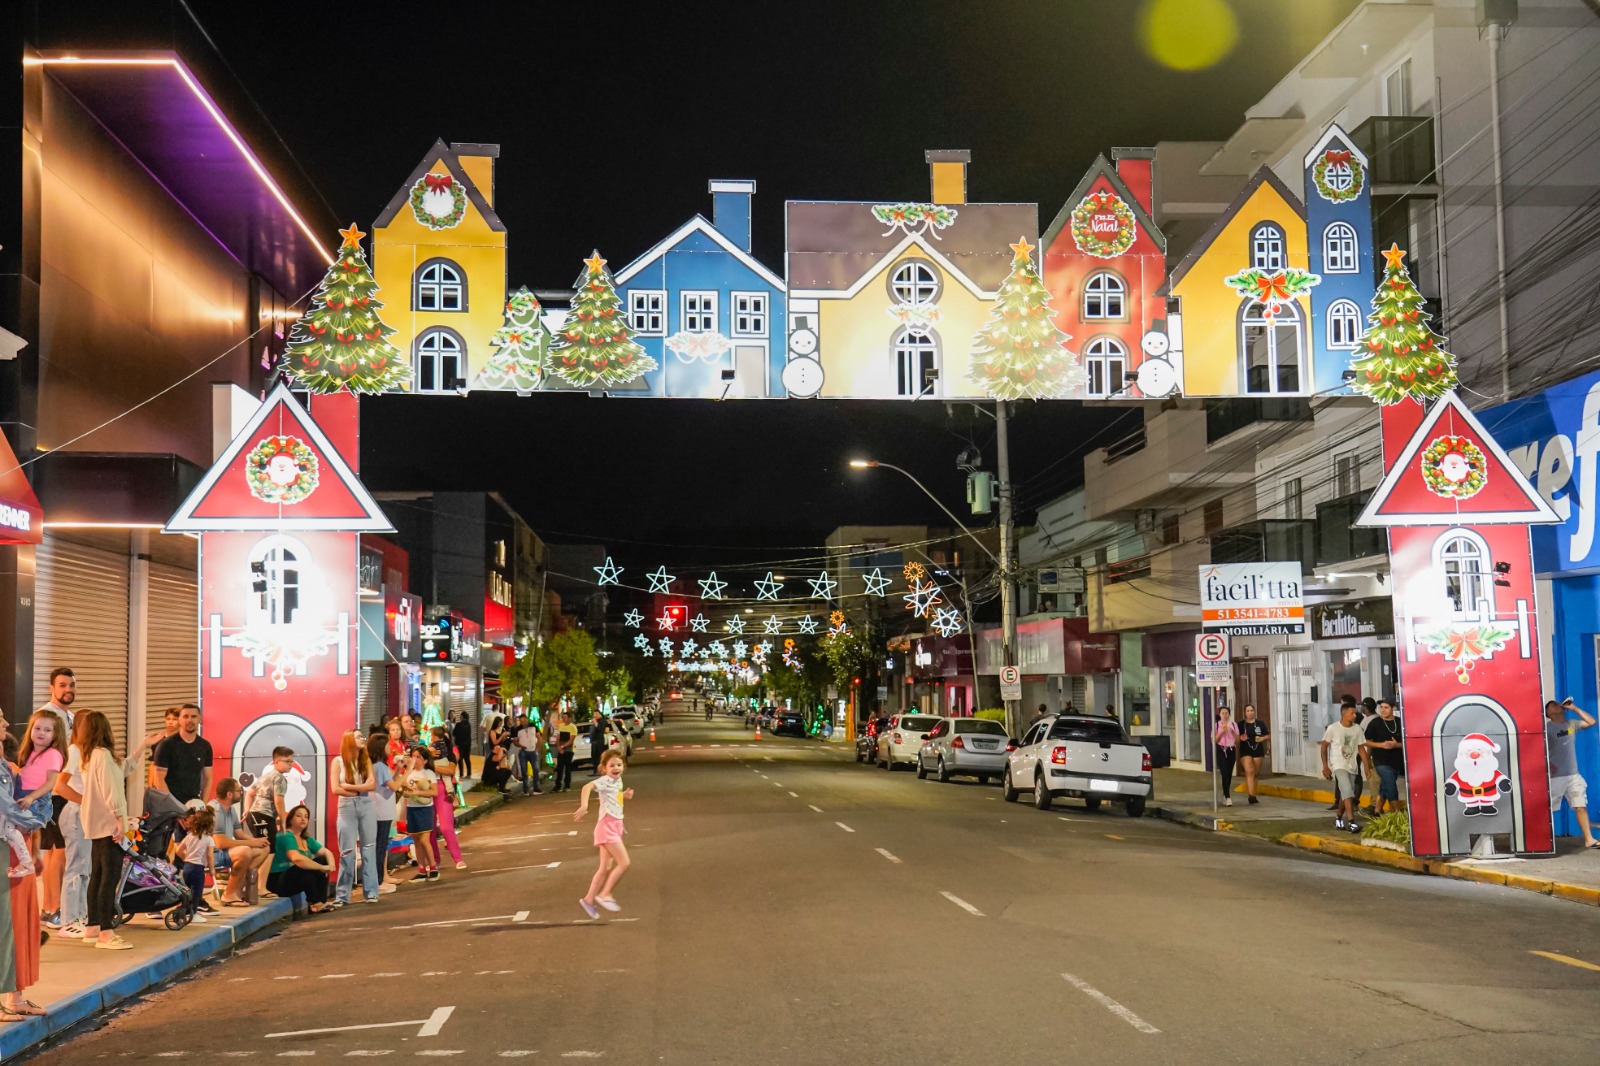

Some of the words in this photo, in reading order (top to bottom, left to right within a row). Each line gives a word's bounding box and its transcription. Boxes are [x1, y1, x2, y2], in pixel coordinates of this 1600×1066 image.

[1091, 219, 1119, 232] Natal
[1205, 574, 1300, 601] facilitta
[1217, 611, 1230, 620] 51
[1233, 608, 1289, 619] 3541-4783
[1220, 624, 1289, 636] IMOBILIÁRIA
[1321, 610, 1358, 637] facilitta
[1207, 639, 1218, 655] E
[1006, 670, 1014, 680] E
